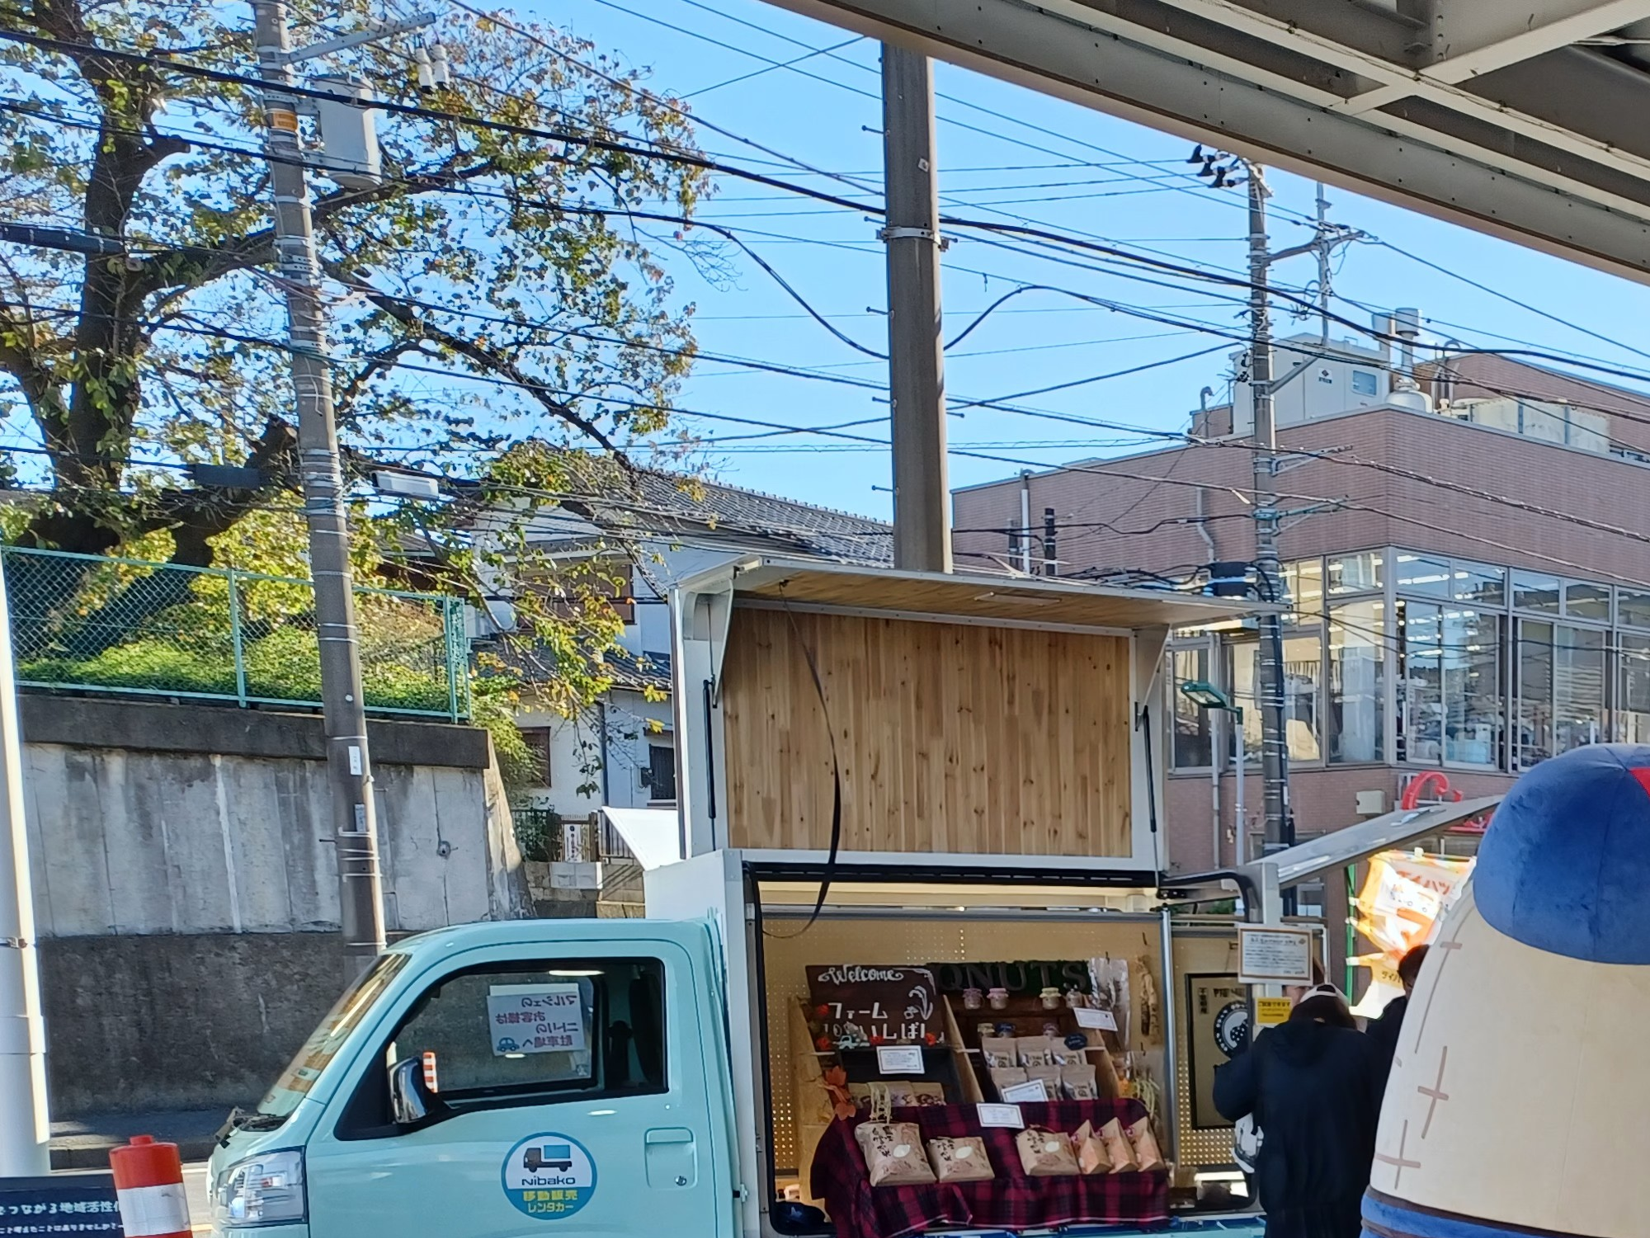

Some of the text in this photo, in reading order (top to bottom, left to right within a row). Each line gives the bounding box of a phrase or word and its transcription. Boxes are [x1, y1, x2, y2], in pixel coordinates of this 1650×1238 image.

[818, 964, 904, 986] Welcome
[521, 1174, 576, 1187] Nibako
[522, 1189, 578, 1201] 移動販売
[527, 1201, 574, 1214] レンタカー
